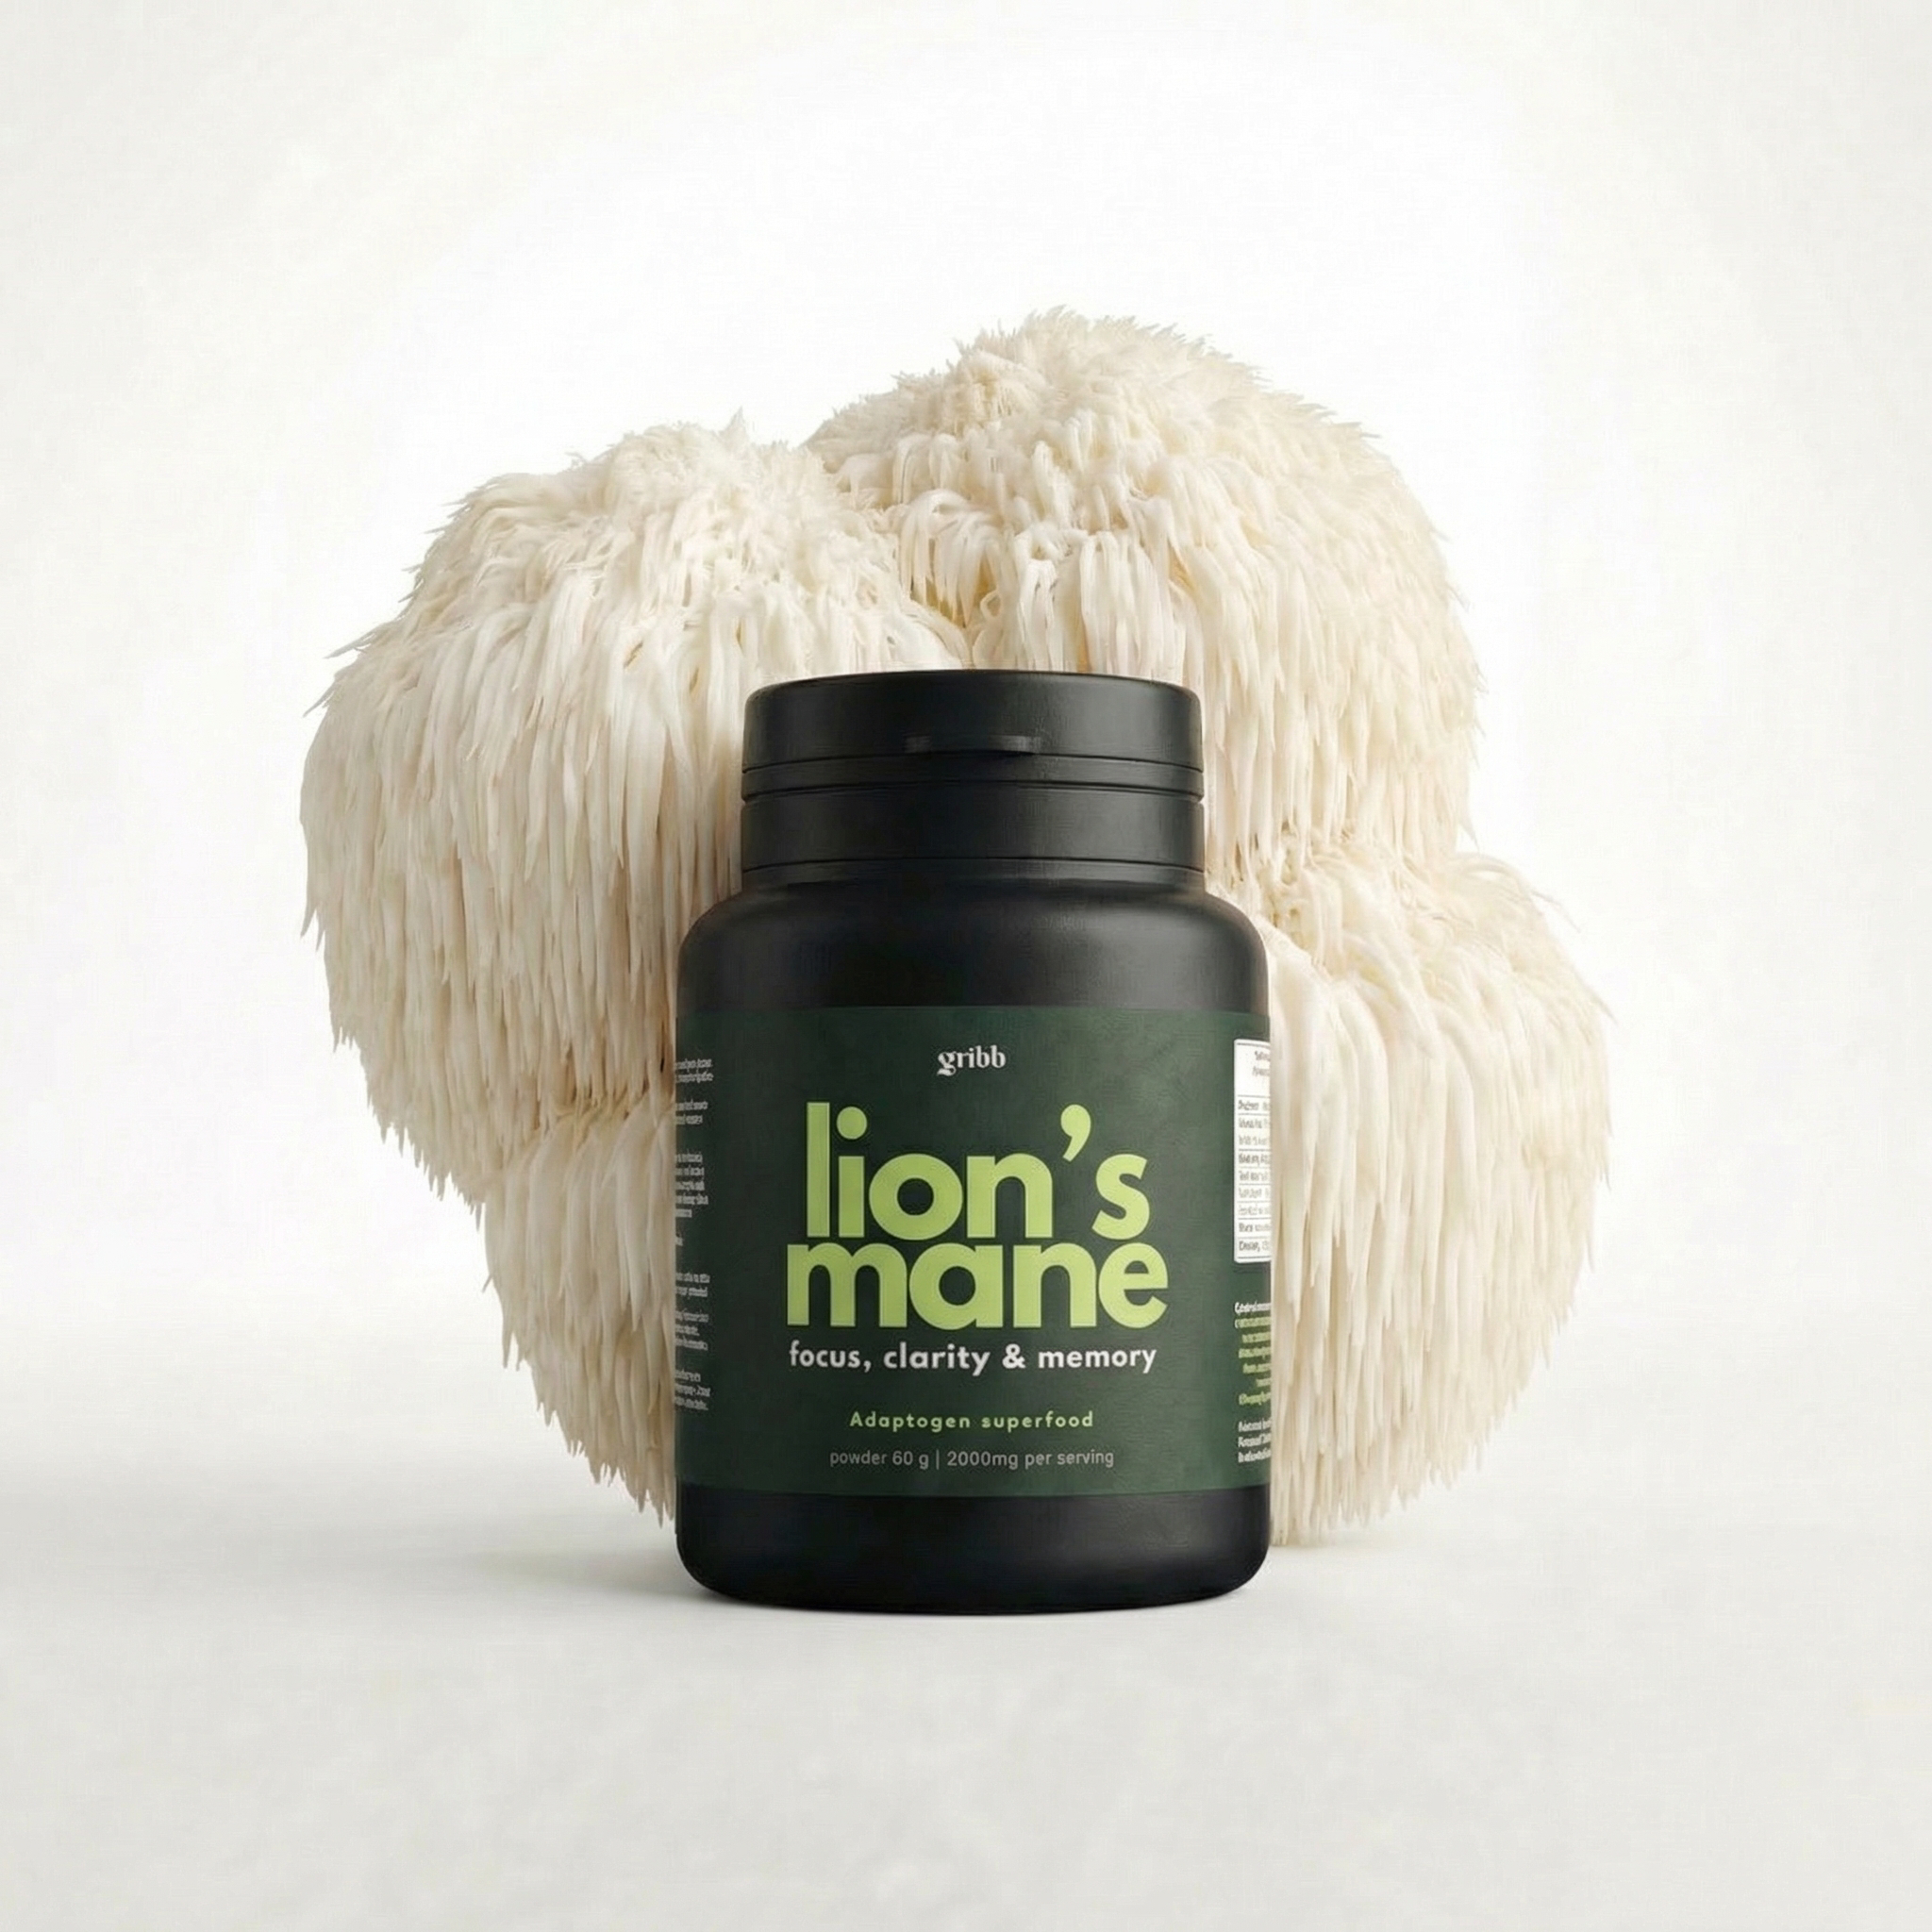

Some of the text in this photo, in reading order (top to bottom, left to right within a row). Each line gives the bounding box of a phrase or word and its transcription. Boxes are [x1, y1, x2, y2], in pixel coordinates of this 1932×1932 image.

[938, 1044, 1007, 1076] gribb
[787, 1241, 1169, 1330] mane
[789, 1340, 1157, 1376] focus, clarity & memory
[850, 1410, 1094, 1433] Adaptogen superfood
[829, 1450, 888, 1467] powder
[891, 1451, 913, 1465] 60
[918, 1455, 930, 1470] g
[946, 1451, 1019, 1470] 2000mg
[1024, 1454, 1051, 1470] per
[1057, 1449, 1114, 1468] serving
